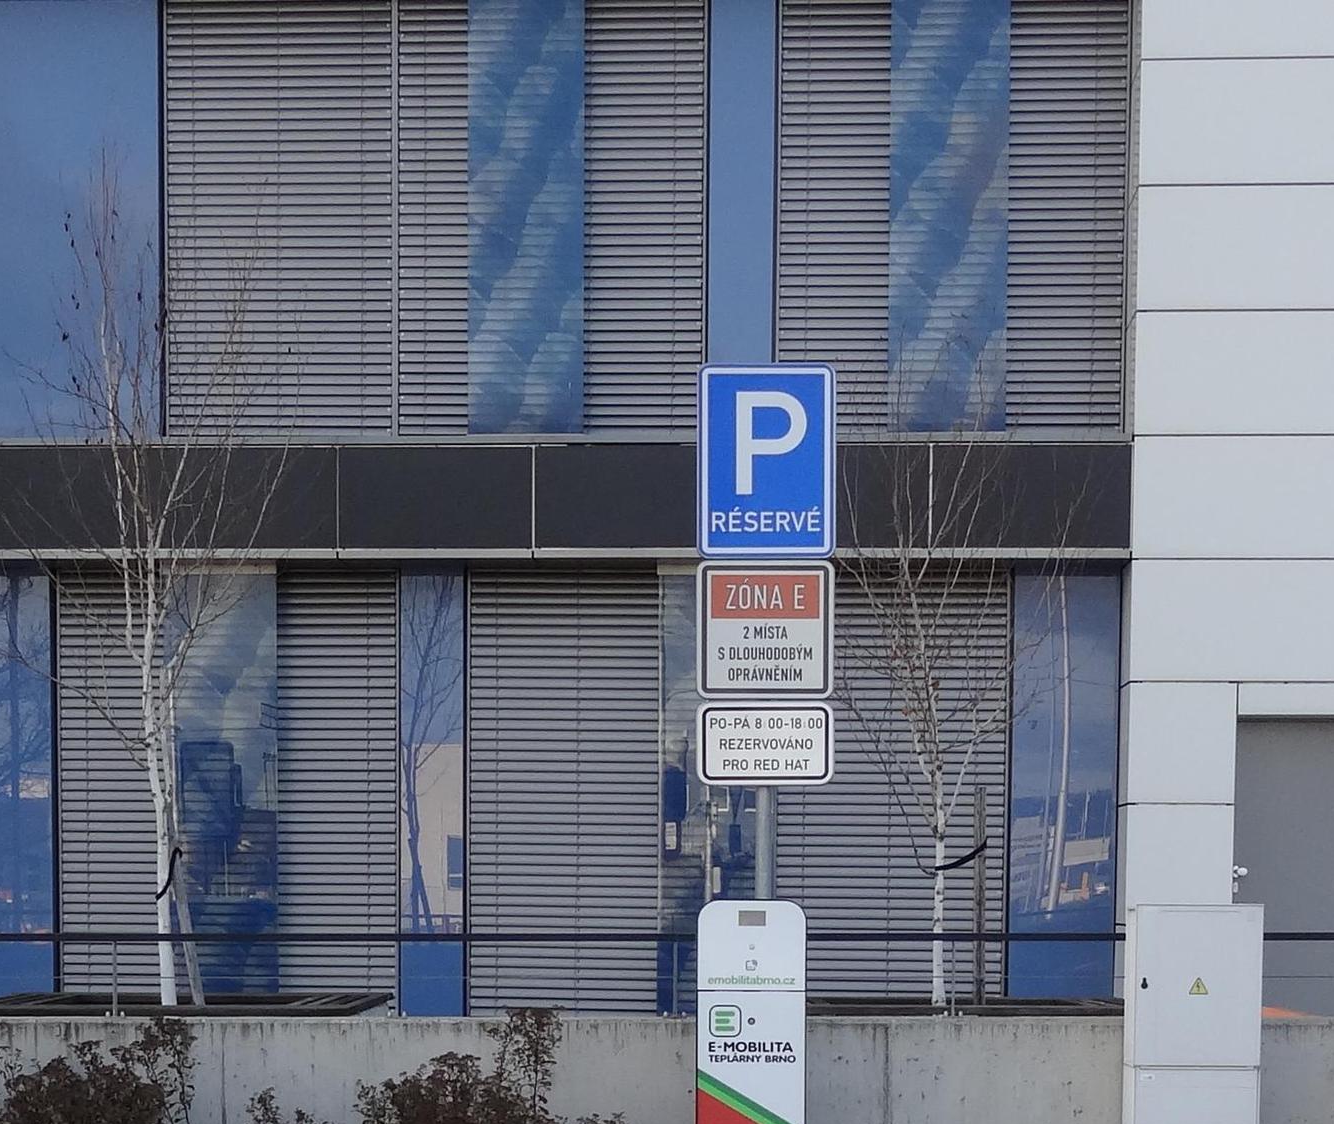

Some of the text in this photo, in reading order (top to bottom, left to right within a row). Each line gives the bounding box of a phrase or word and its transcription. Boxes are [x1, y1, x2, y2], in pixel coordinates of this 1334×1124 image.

[736, 391, 807, 495] P
[711, 506, 821, 532] RÉSERVÉ
[725, 578, 805, 610] ZÓNA E
[743, 622, 788, 640] 2 MÍSTA
[717, 643, 813, 661] S DLOUHODOBÝM
[728, 664, 803, 682] OPRÁVNĚNÍM
[719, 735, 813, 751] REZERVOVÁNO
[722, 759, 811, 771] PRO RED HAT
[708, 1041, 794, 1053] E-MOBILITA
[708, 1053, 797, 1064] TEPLÁRNY BRNO
